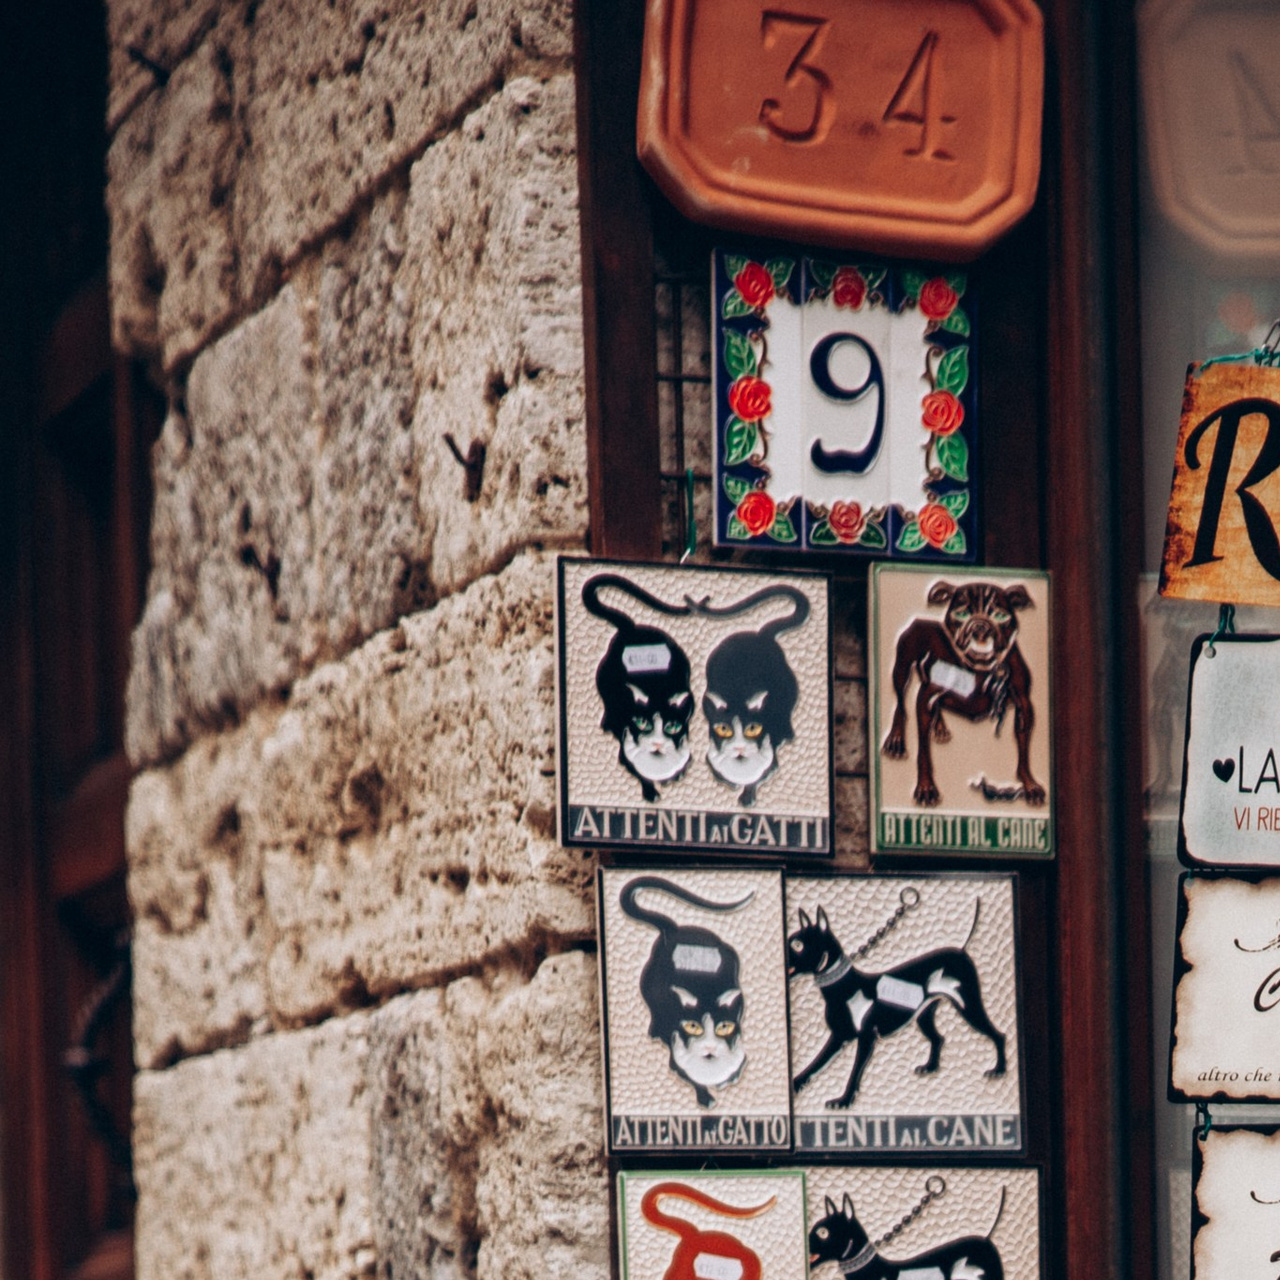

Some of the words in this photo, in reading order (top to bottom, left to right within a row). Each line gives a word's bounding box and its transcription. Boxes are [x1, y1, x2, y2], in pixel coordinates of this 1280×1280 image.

[808, 331, 886, 475] 9
[574, 807, 710, 845] ATTENTI
[730, 812, 824, 849] GATTI
[884, 814, 962, 847] ATTENTI
[998, 819, 1046, 851] CANE
[1234, 806, 1252, 831] VI
[1197, 1067, 1239, 1083] altro
[1244, 1066, 1272, 1083] che
[617, 1116, 702, 1146] ATTENTI
[717, 1117, 787, 1145] GATTO
[926, 1115, 1016, 1147] CANE
